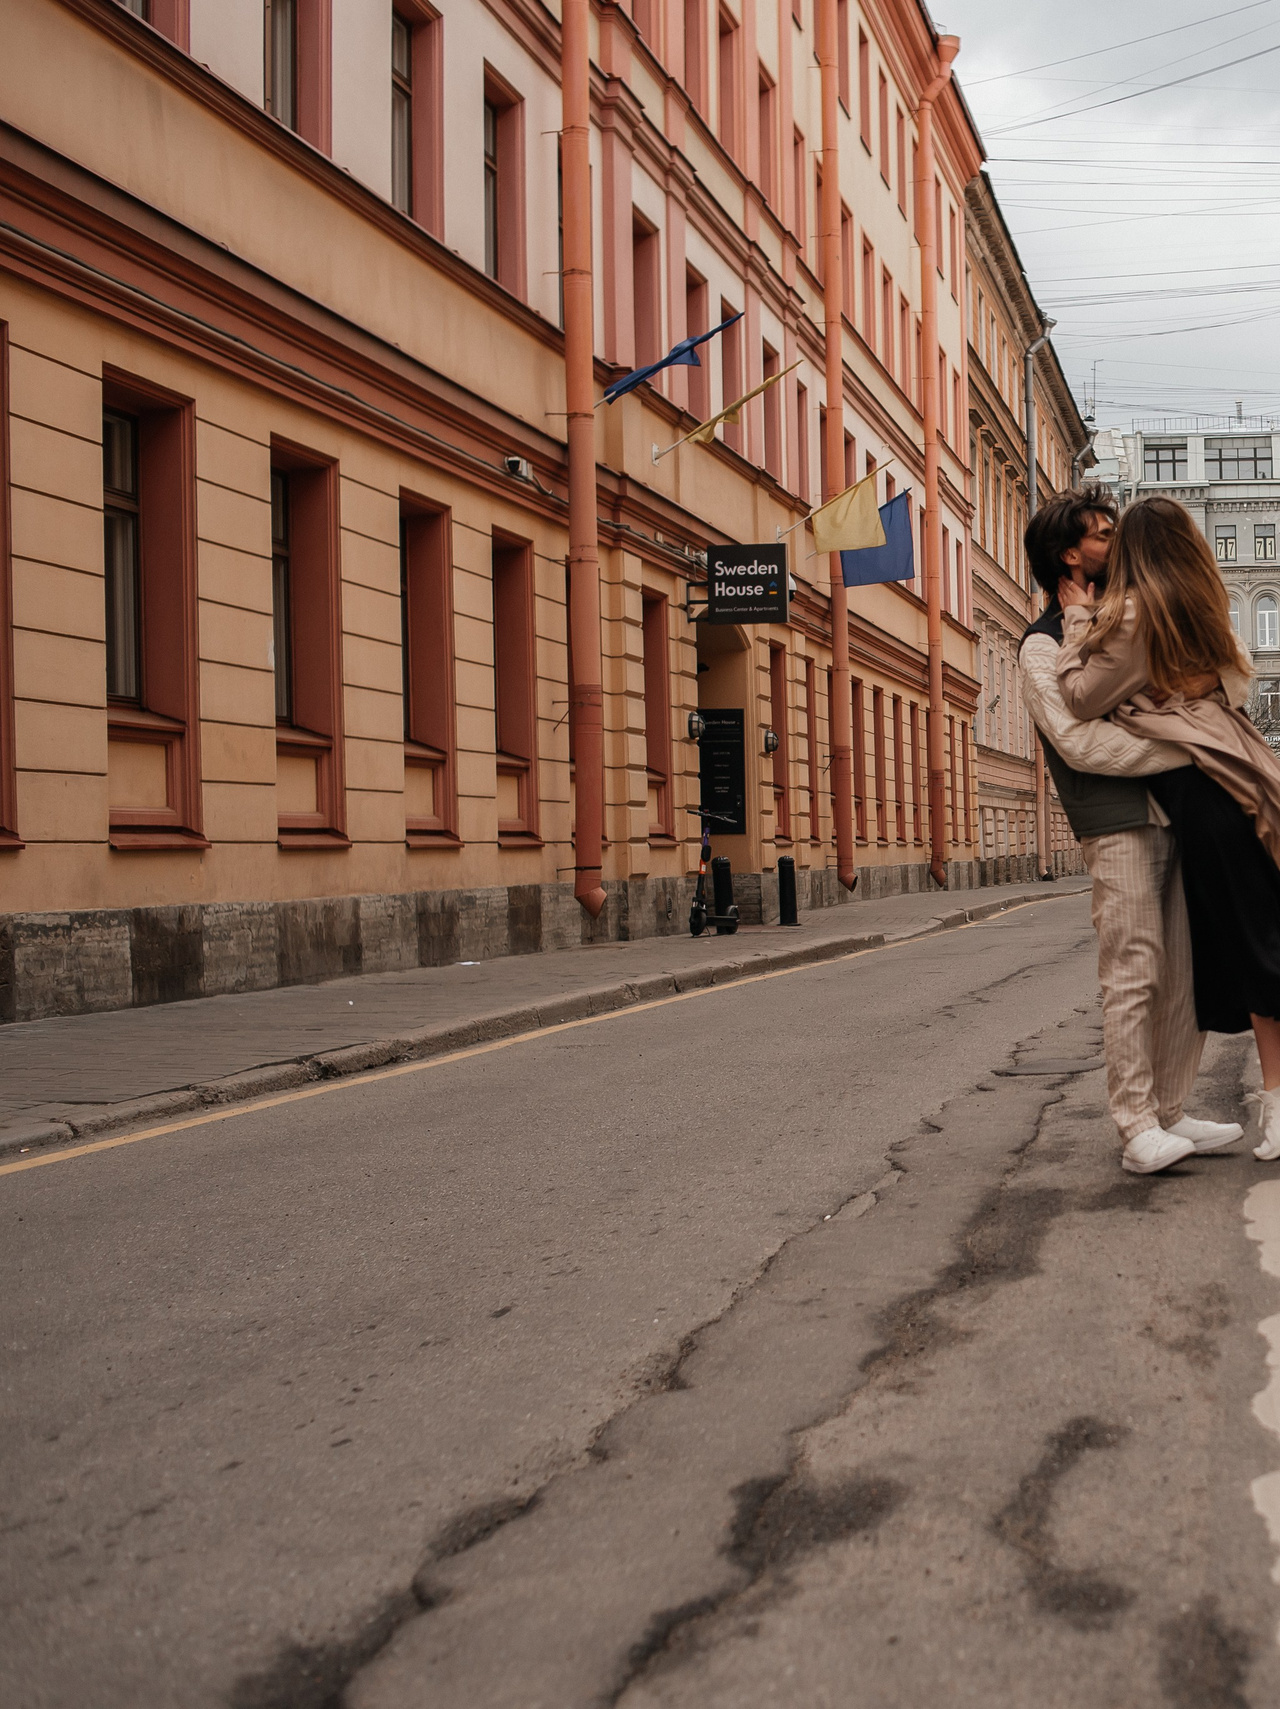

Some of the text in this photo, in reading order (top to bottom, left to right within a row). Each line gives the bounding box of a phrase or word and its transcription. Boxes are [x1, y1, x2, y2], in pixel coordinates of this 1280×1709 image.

[1217, 541, 1235, 557] 77
[1256, 540, 1273, 556] 71
[715, 559, 779, 577] Sweden
[715, 581, 765, 597] House
